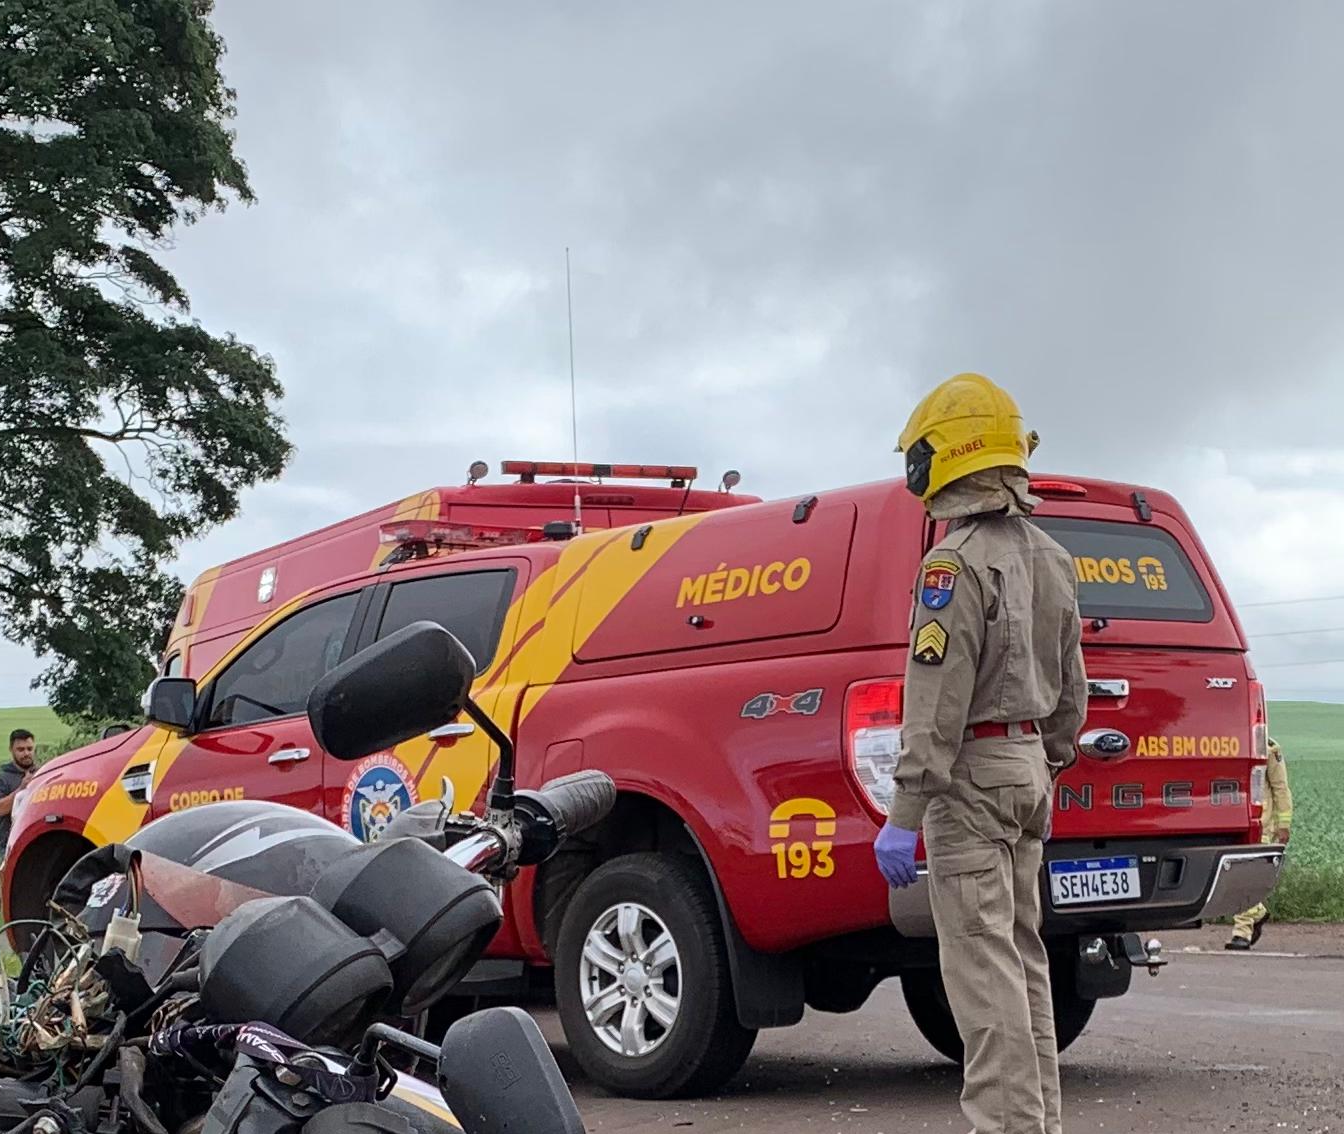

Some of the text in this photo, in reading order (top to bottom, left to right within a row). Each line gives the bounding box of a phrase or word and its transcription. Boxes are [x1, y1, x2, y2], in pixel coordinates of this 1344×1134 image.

[950, 439, 986, 459] RUBEL
[676, 557, 811, 608] MÉDICO
[1073, 557, 1136, 584] IROS
[1142, 575, 1168, 591] 193
[1136, 736, 1240, 757] ABS BM 0050
[67, 781, 98, 799] 0050
[1059, 779, 1242, 811] NGER
[771, 841, 835, 879] 193
[1059, 872, 1130, 899] SEH4E38
